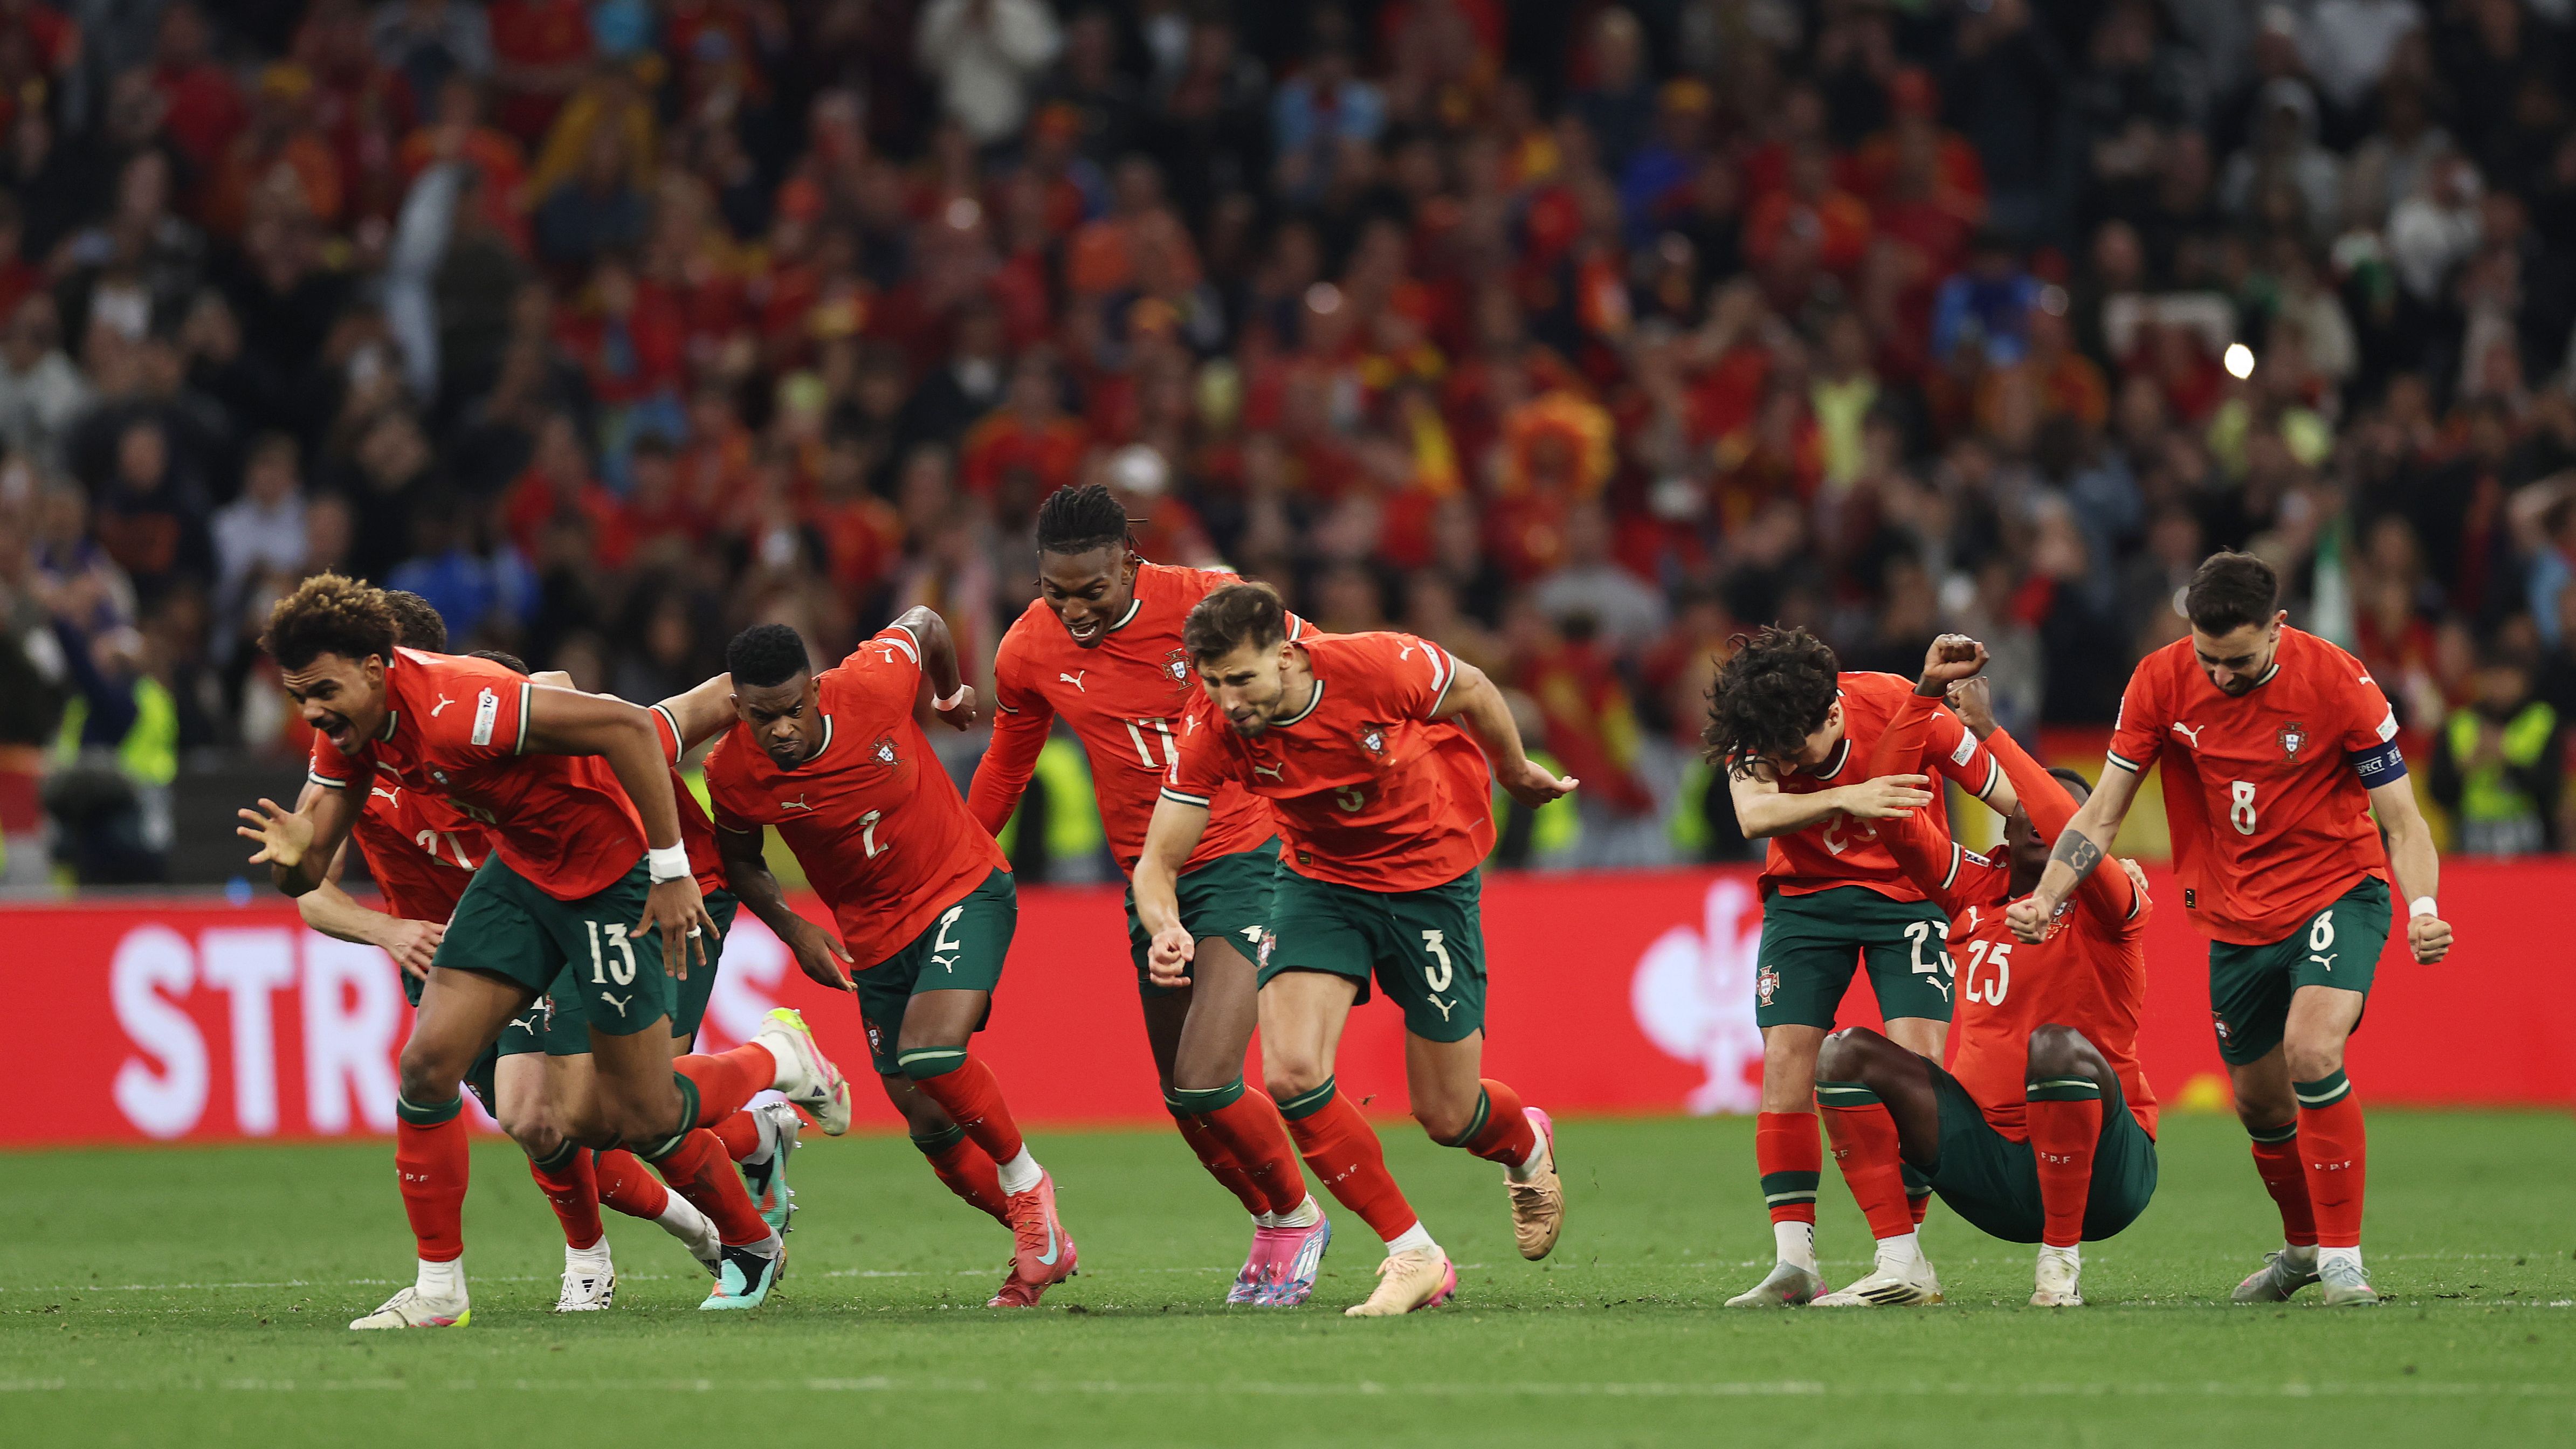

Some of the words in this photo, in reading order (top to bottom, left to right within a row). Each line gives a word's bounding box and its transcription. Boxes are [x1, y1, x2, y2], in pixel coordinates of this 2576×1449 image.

[1124, 717, 1176, 768] 17
[858, 809, 889, 860] 2
[2230, 780, 2256, 836] 8
[583, 920, 637, 986] 13
[934, 905, 964, 953] 2
[2309, 909, 2334, 951] 8
[1421, 929, 1452, 992] 3
[1966, 939, 2013, 1006] 25
